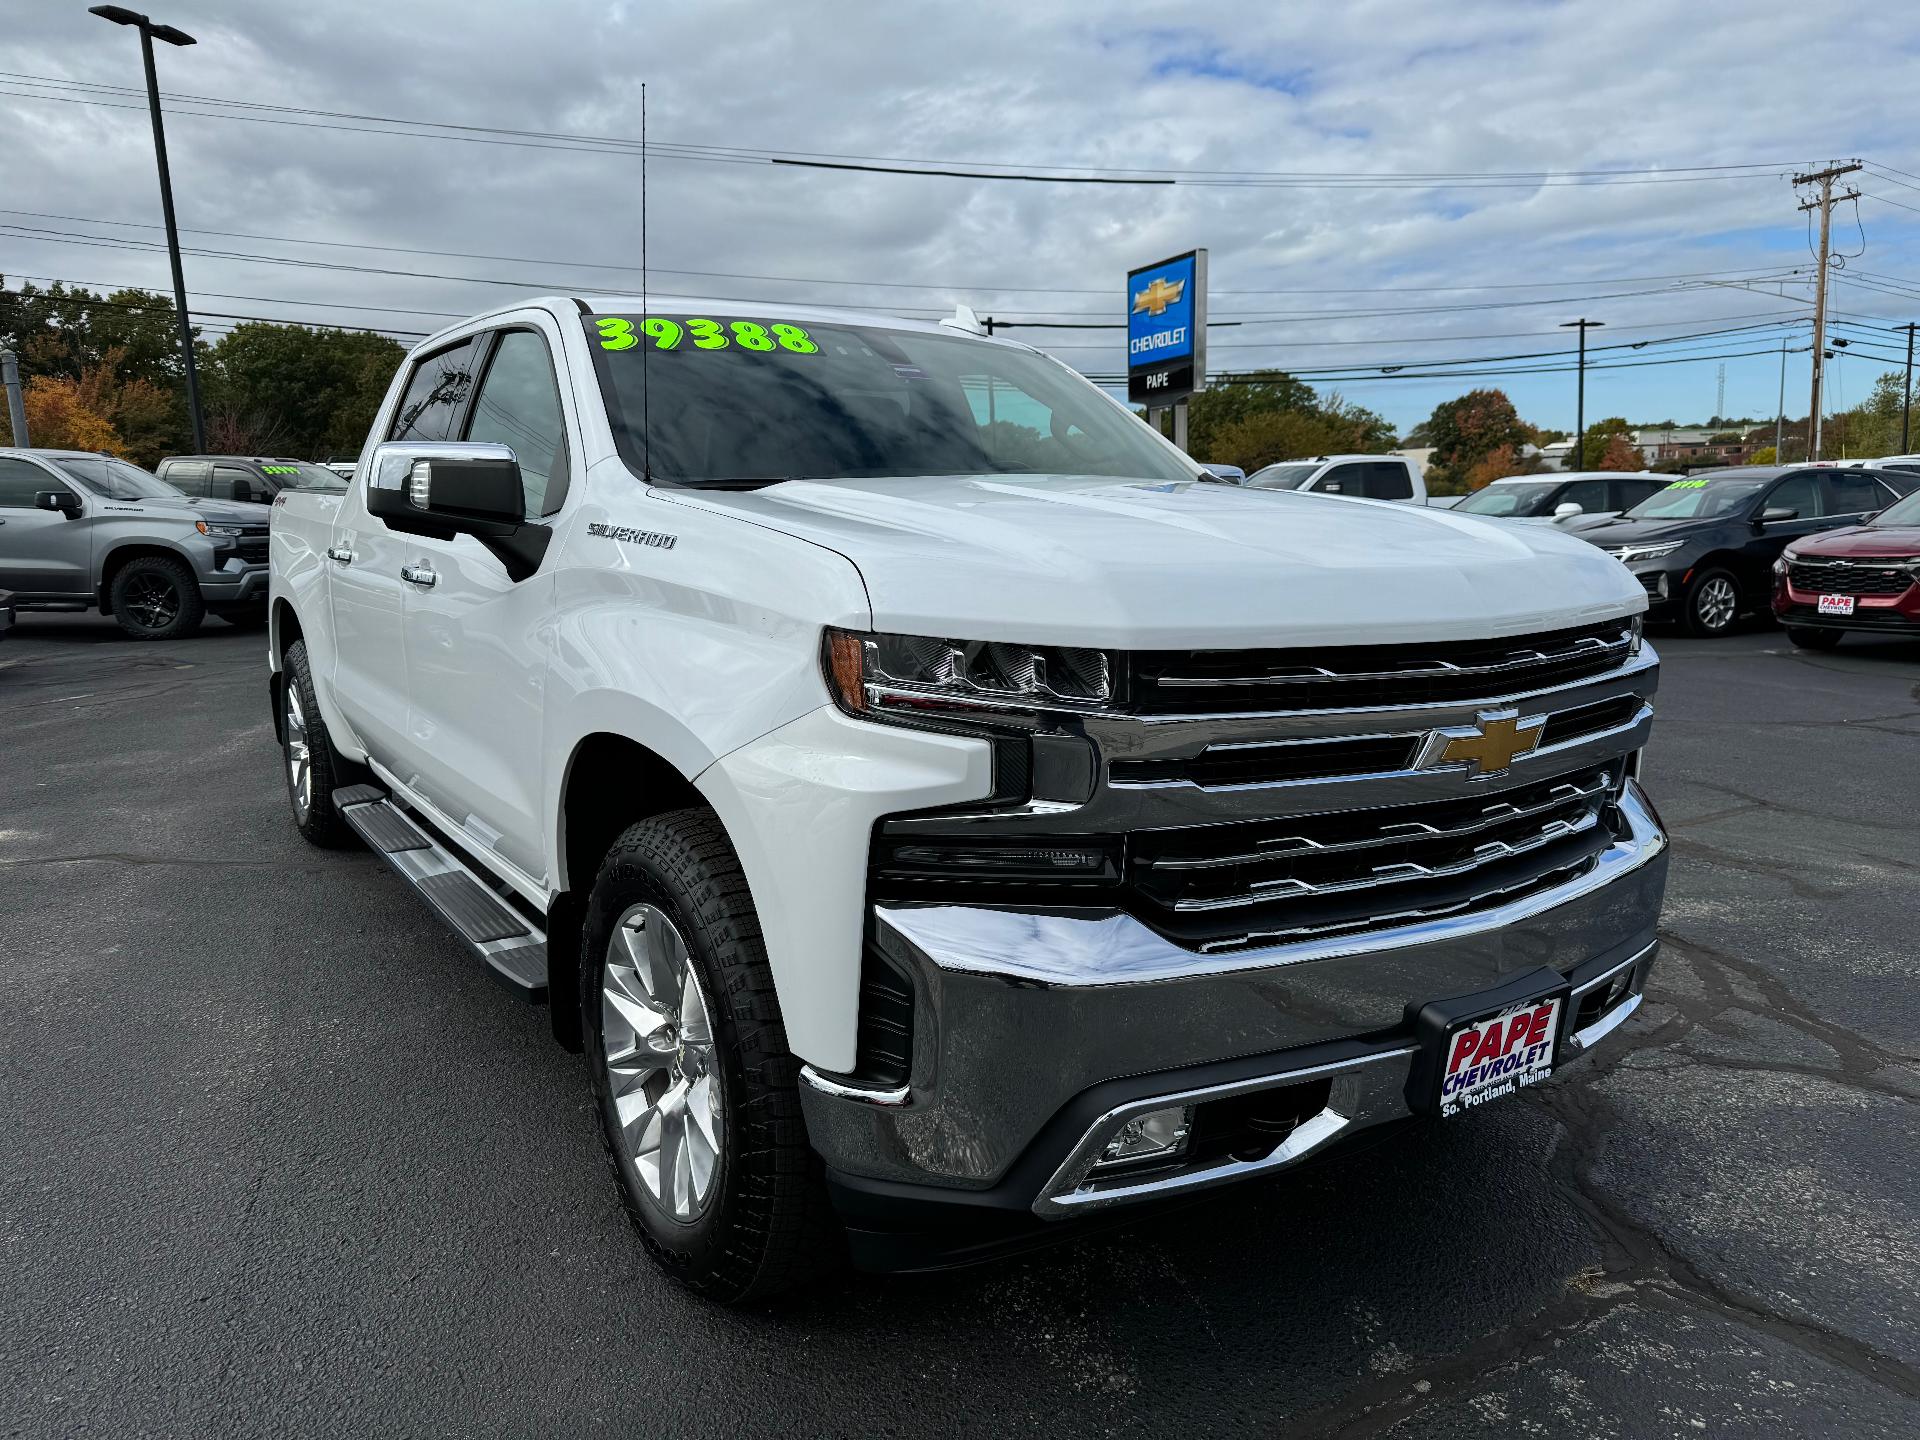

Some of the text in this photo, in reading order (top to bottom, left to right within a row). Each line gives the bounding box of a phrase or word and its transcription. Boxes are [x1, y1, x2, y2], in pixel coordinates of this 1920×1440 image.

[595, 317, 819, 354] 39388
[1131, 327, 1187, 354] CHEVROLET
[1146, 371, 1169, 389] PAPE
[586, 522, 678, 550] SILVERADO
[1822, 596, 1853, 607] PAPE
[1447, 1003, 1554, 1075] PAPE
[1442, 1040, 1551, 1097] CHEVROLET
[1442, 1103, 1461, 1118] So.
[1464, 1077, 1516, 1109] Portland,
[1519, 1068, 1552, 1088] Maine
